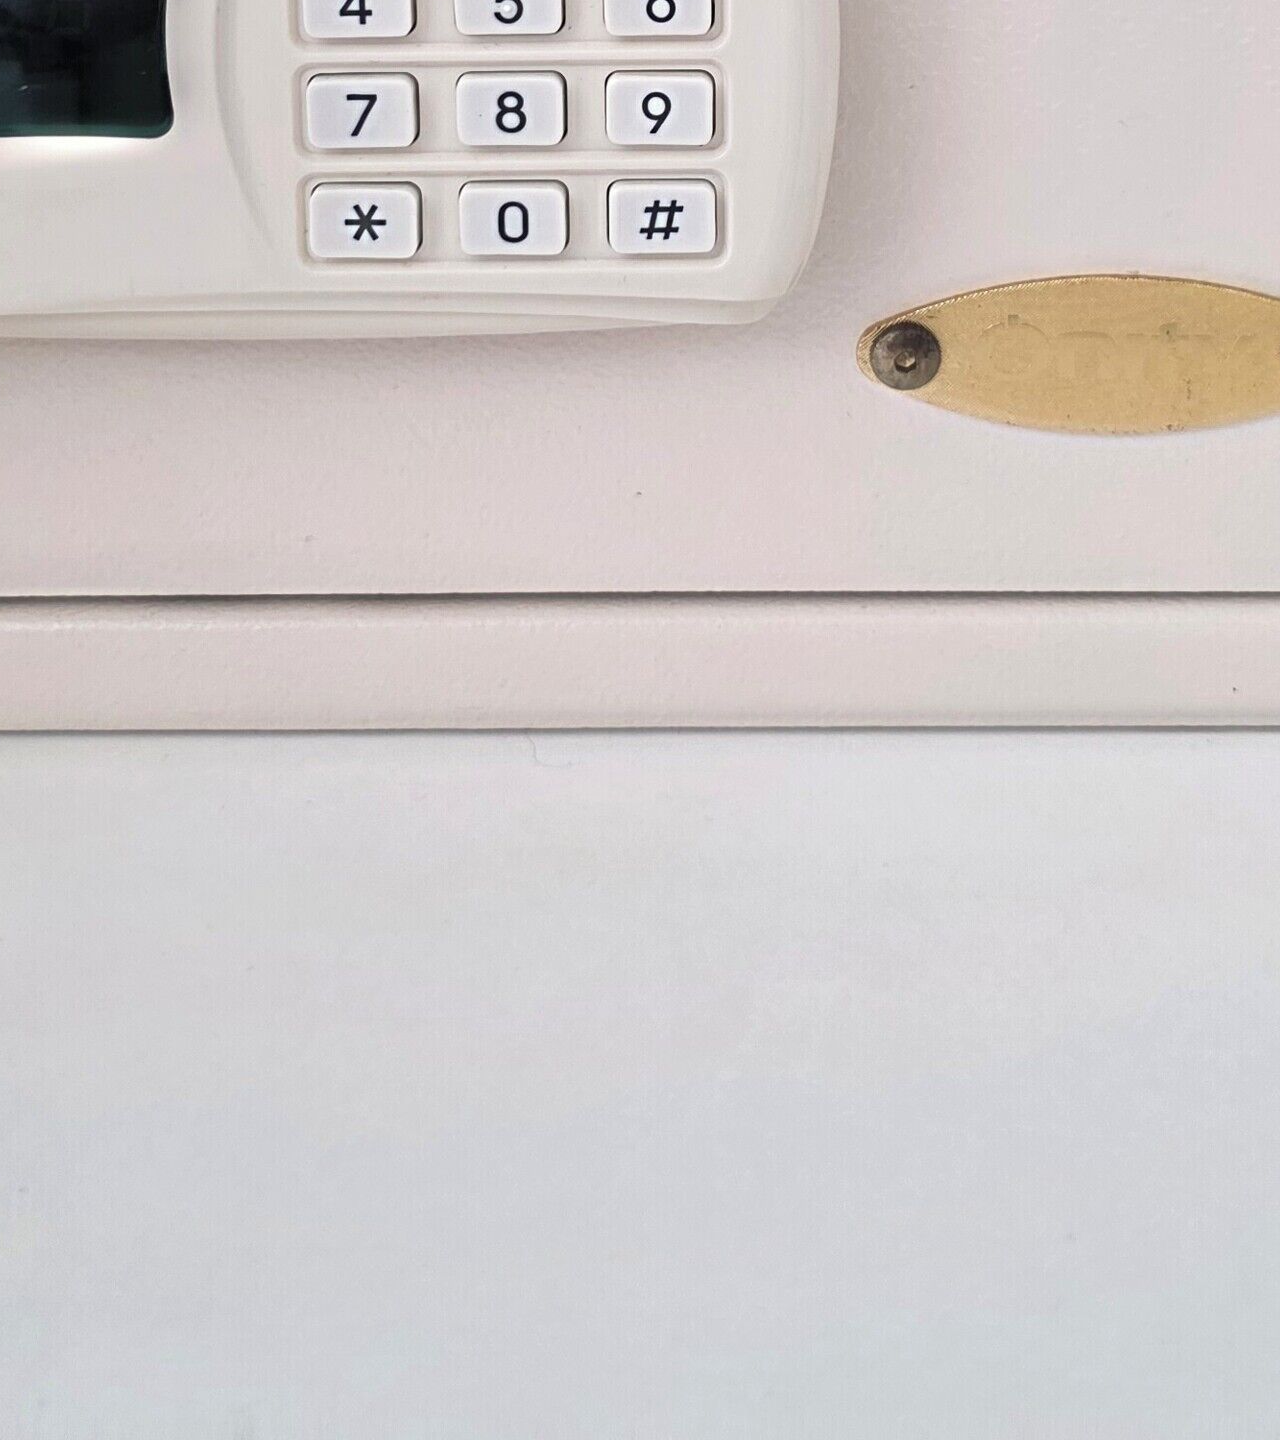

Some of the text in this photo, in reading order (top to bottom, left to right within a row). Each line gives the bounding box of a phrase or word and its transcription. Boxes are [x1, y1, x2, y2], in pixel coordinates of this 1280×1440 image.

[346, 91, 672, 137] 7 8 9
[498, 201, 529, 243] 0
[639, 199, 684, 240] #
